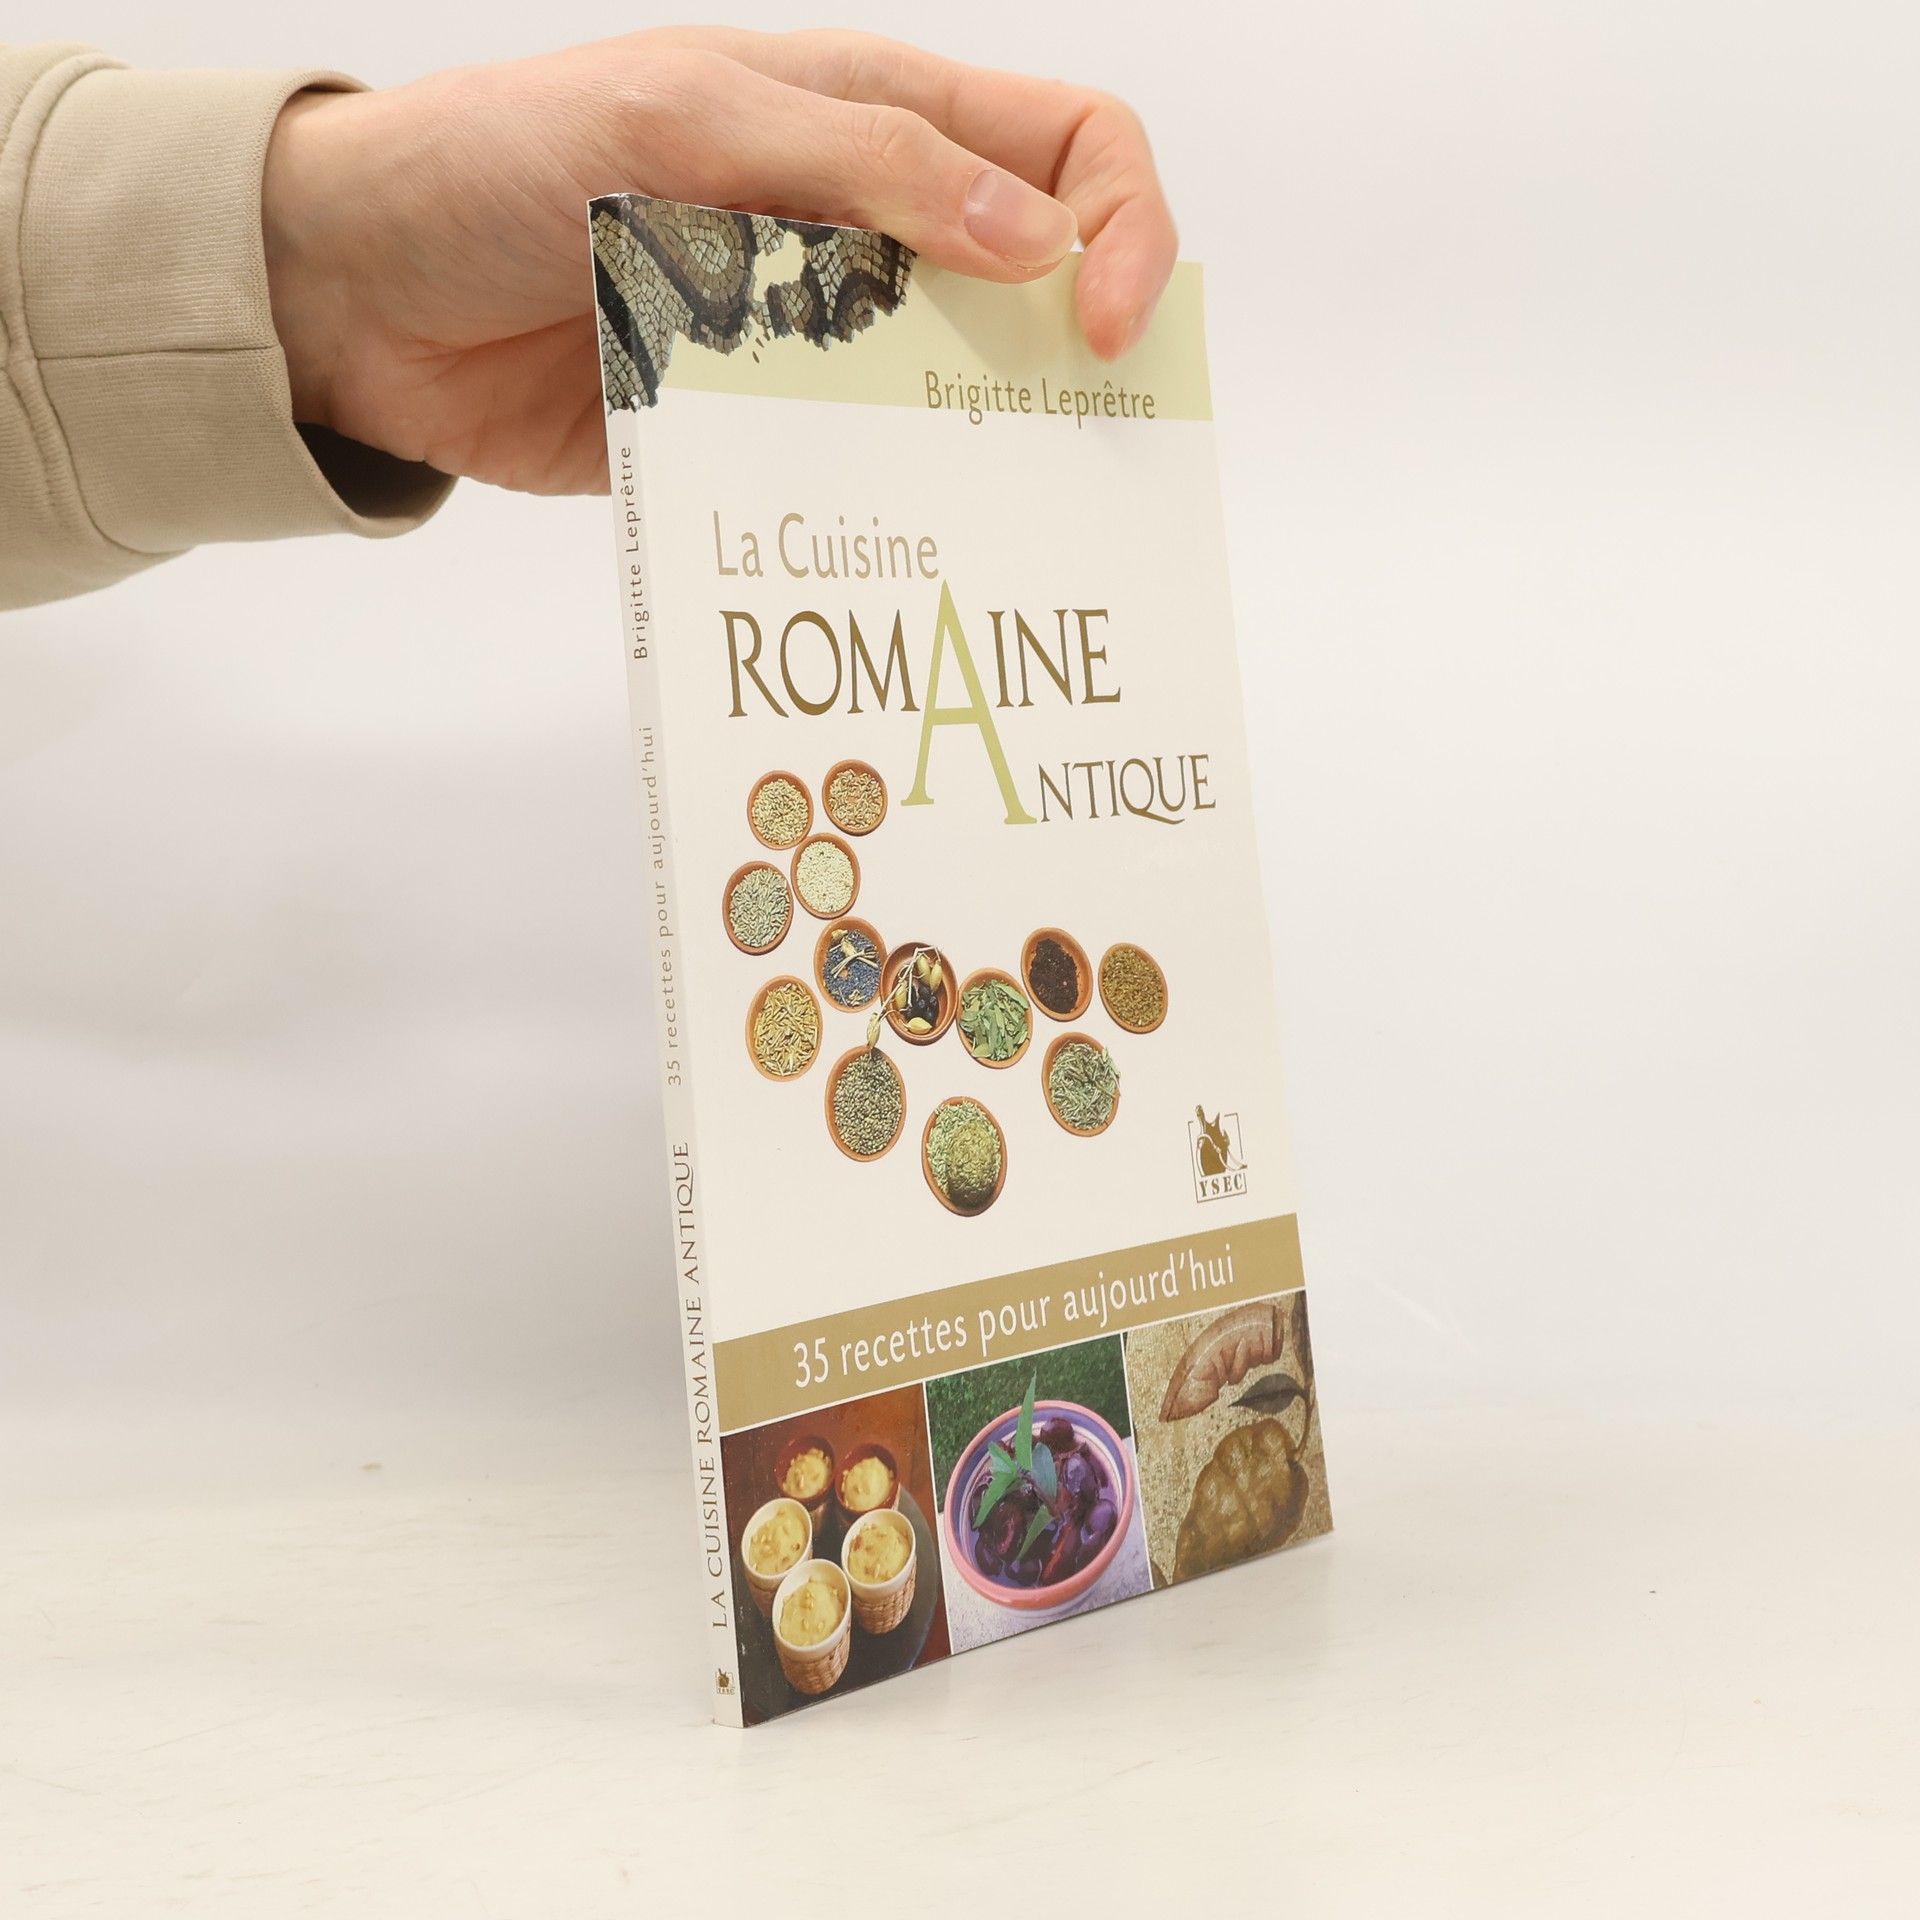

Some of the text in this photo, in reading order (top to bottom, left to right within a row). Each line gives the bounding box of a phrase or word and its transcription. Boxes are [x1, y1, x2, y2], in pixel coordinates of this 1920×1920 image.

[925, 370, 1156, 429] Brigitte Leprêtre
[620, 446, 650, 660] Brigitte Leprêtre
[713, 510, 939, 578] La Cuisine
[718, 579, 1122, 722] ROMAINE
[655, 881, 674, 938] pour
[661, 949, 679, 1049] recettes
[668, 1060, 682, 1086] 35
[1199, 1173, 1243, 1198] YSEC
[793, 1243, 1235, 1388] 35 recettes pour aujourd'hui
[673, 1142, 729, 1629] LA CUISINE ROMAINE ANTIQUE
